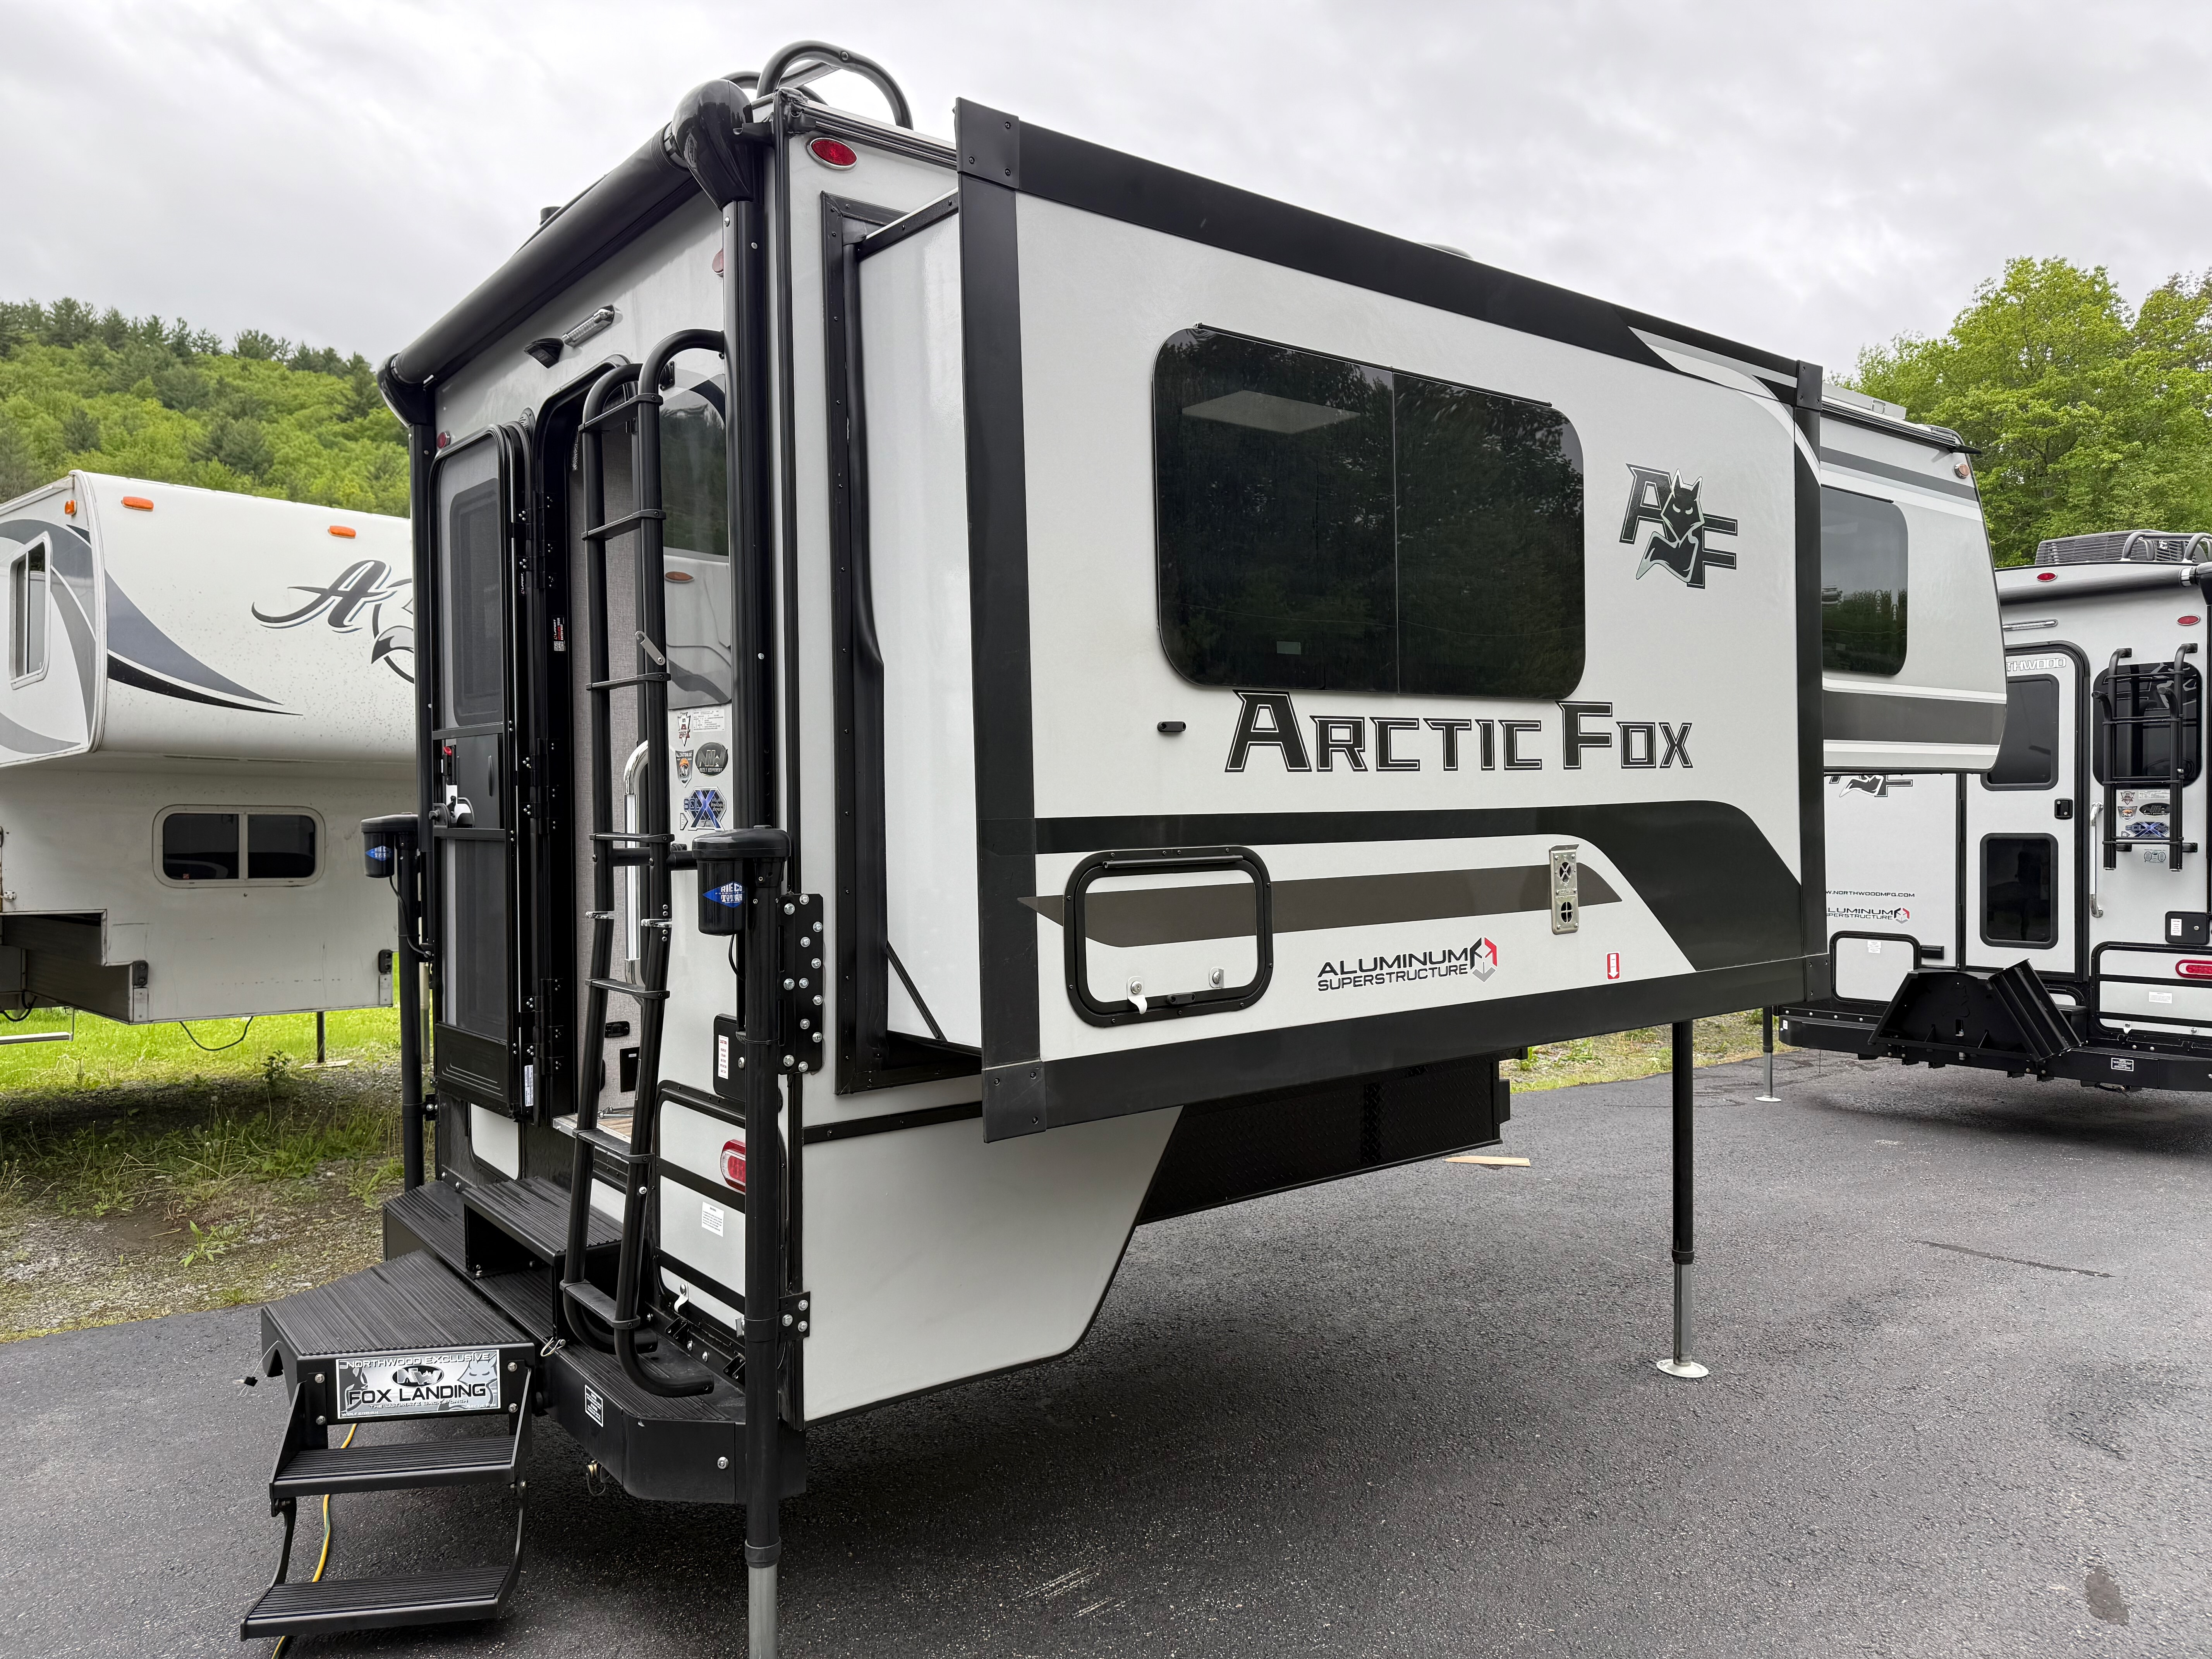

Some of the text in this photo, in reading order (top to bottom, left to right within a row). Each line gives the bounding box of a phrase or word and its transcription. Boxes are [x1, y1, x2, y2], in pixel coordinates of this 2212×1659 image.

[721, 883, 742, 893] RIECO
[1317, 947, 1468, 977] ALUMINUM
[1318, 963, 1468, 991] SUPERSTRUCTURE
[346, 1353, 489, 1369] NORTHWOOD EXCLUSIVE
[349, 1383, 486, 1405] FOX LANDING
